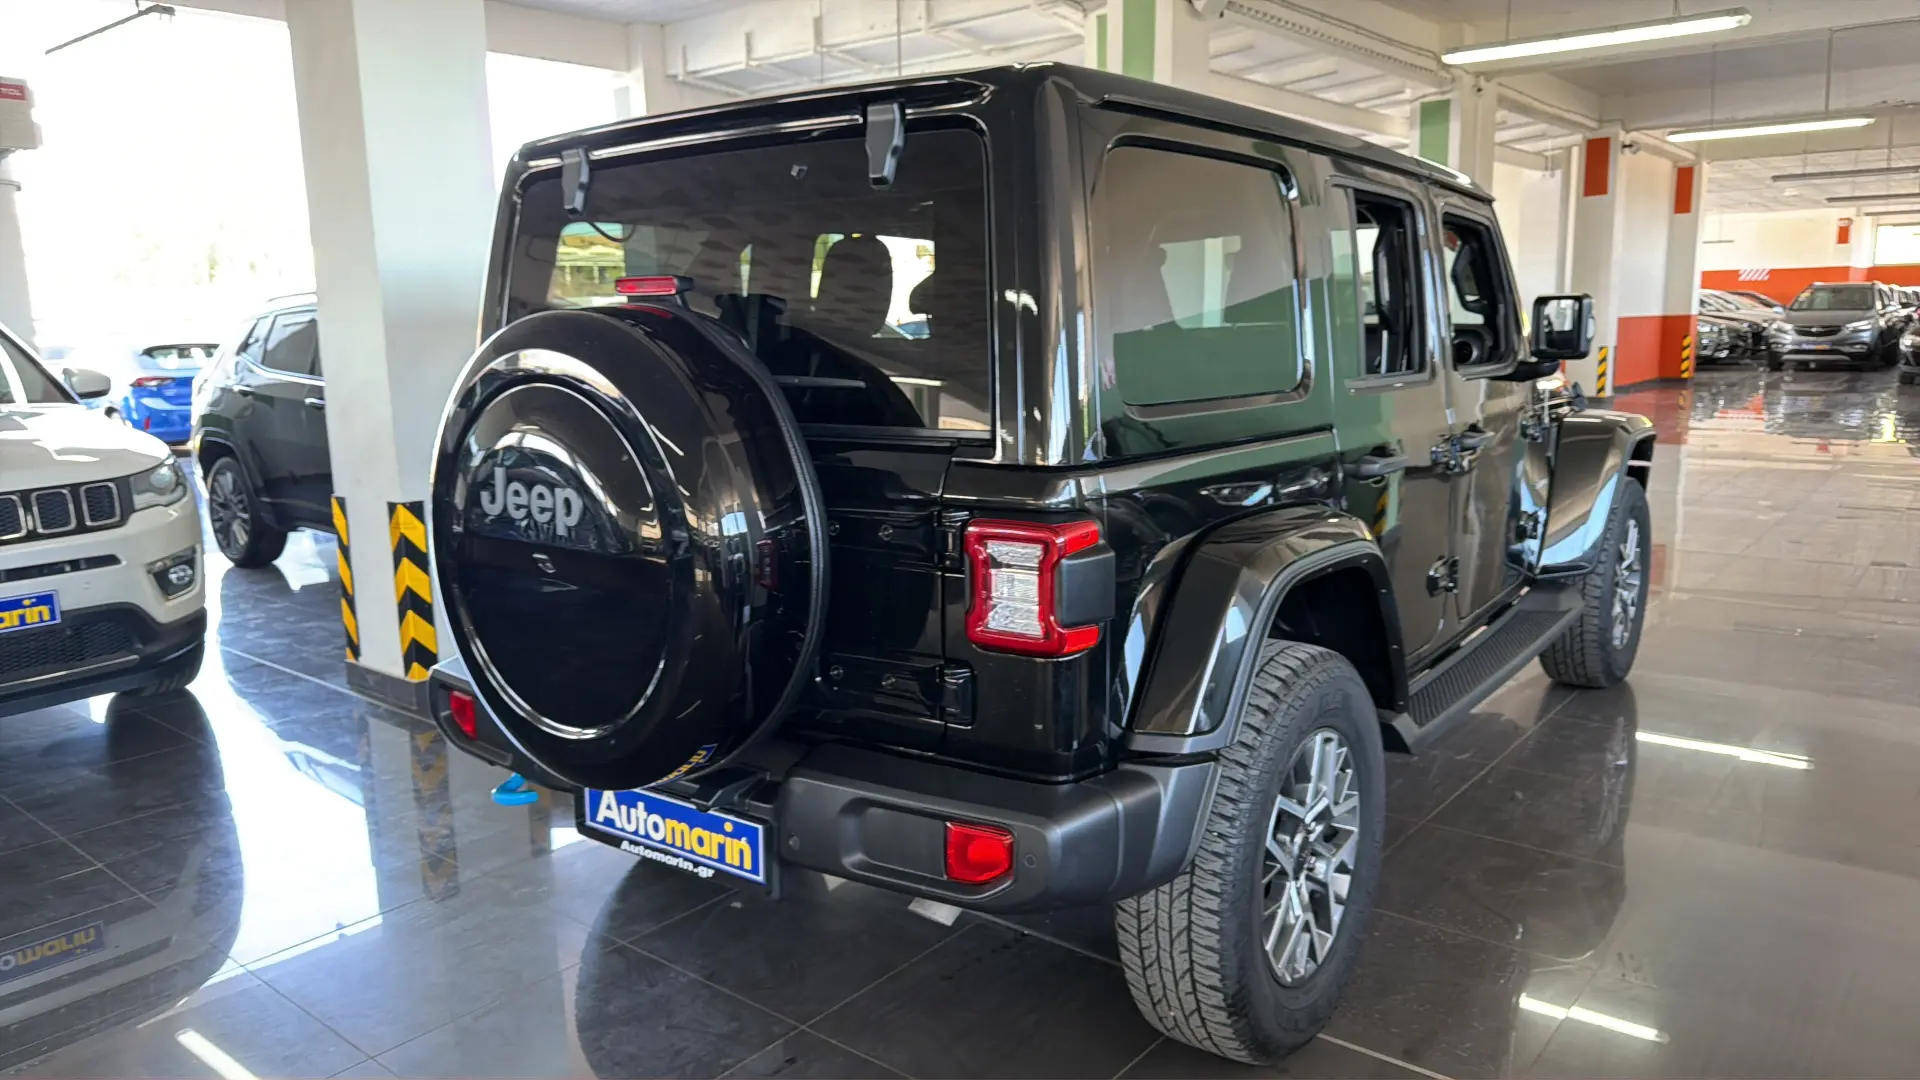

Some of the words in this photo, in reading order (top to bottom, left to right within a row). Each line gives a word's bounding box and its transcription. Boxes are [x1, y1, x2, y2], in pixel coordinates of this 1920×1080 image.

[480, 466, 584, 537] Jeep
[596, 790, 752, 870] Automarin
[620, 840, 715, 878] Automarin.gr
